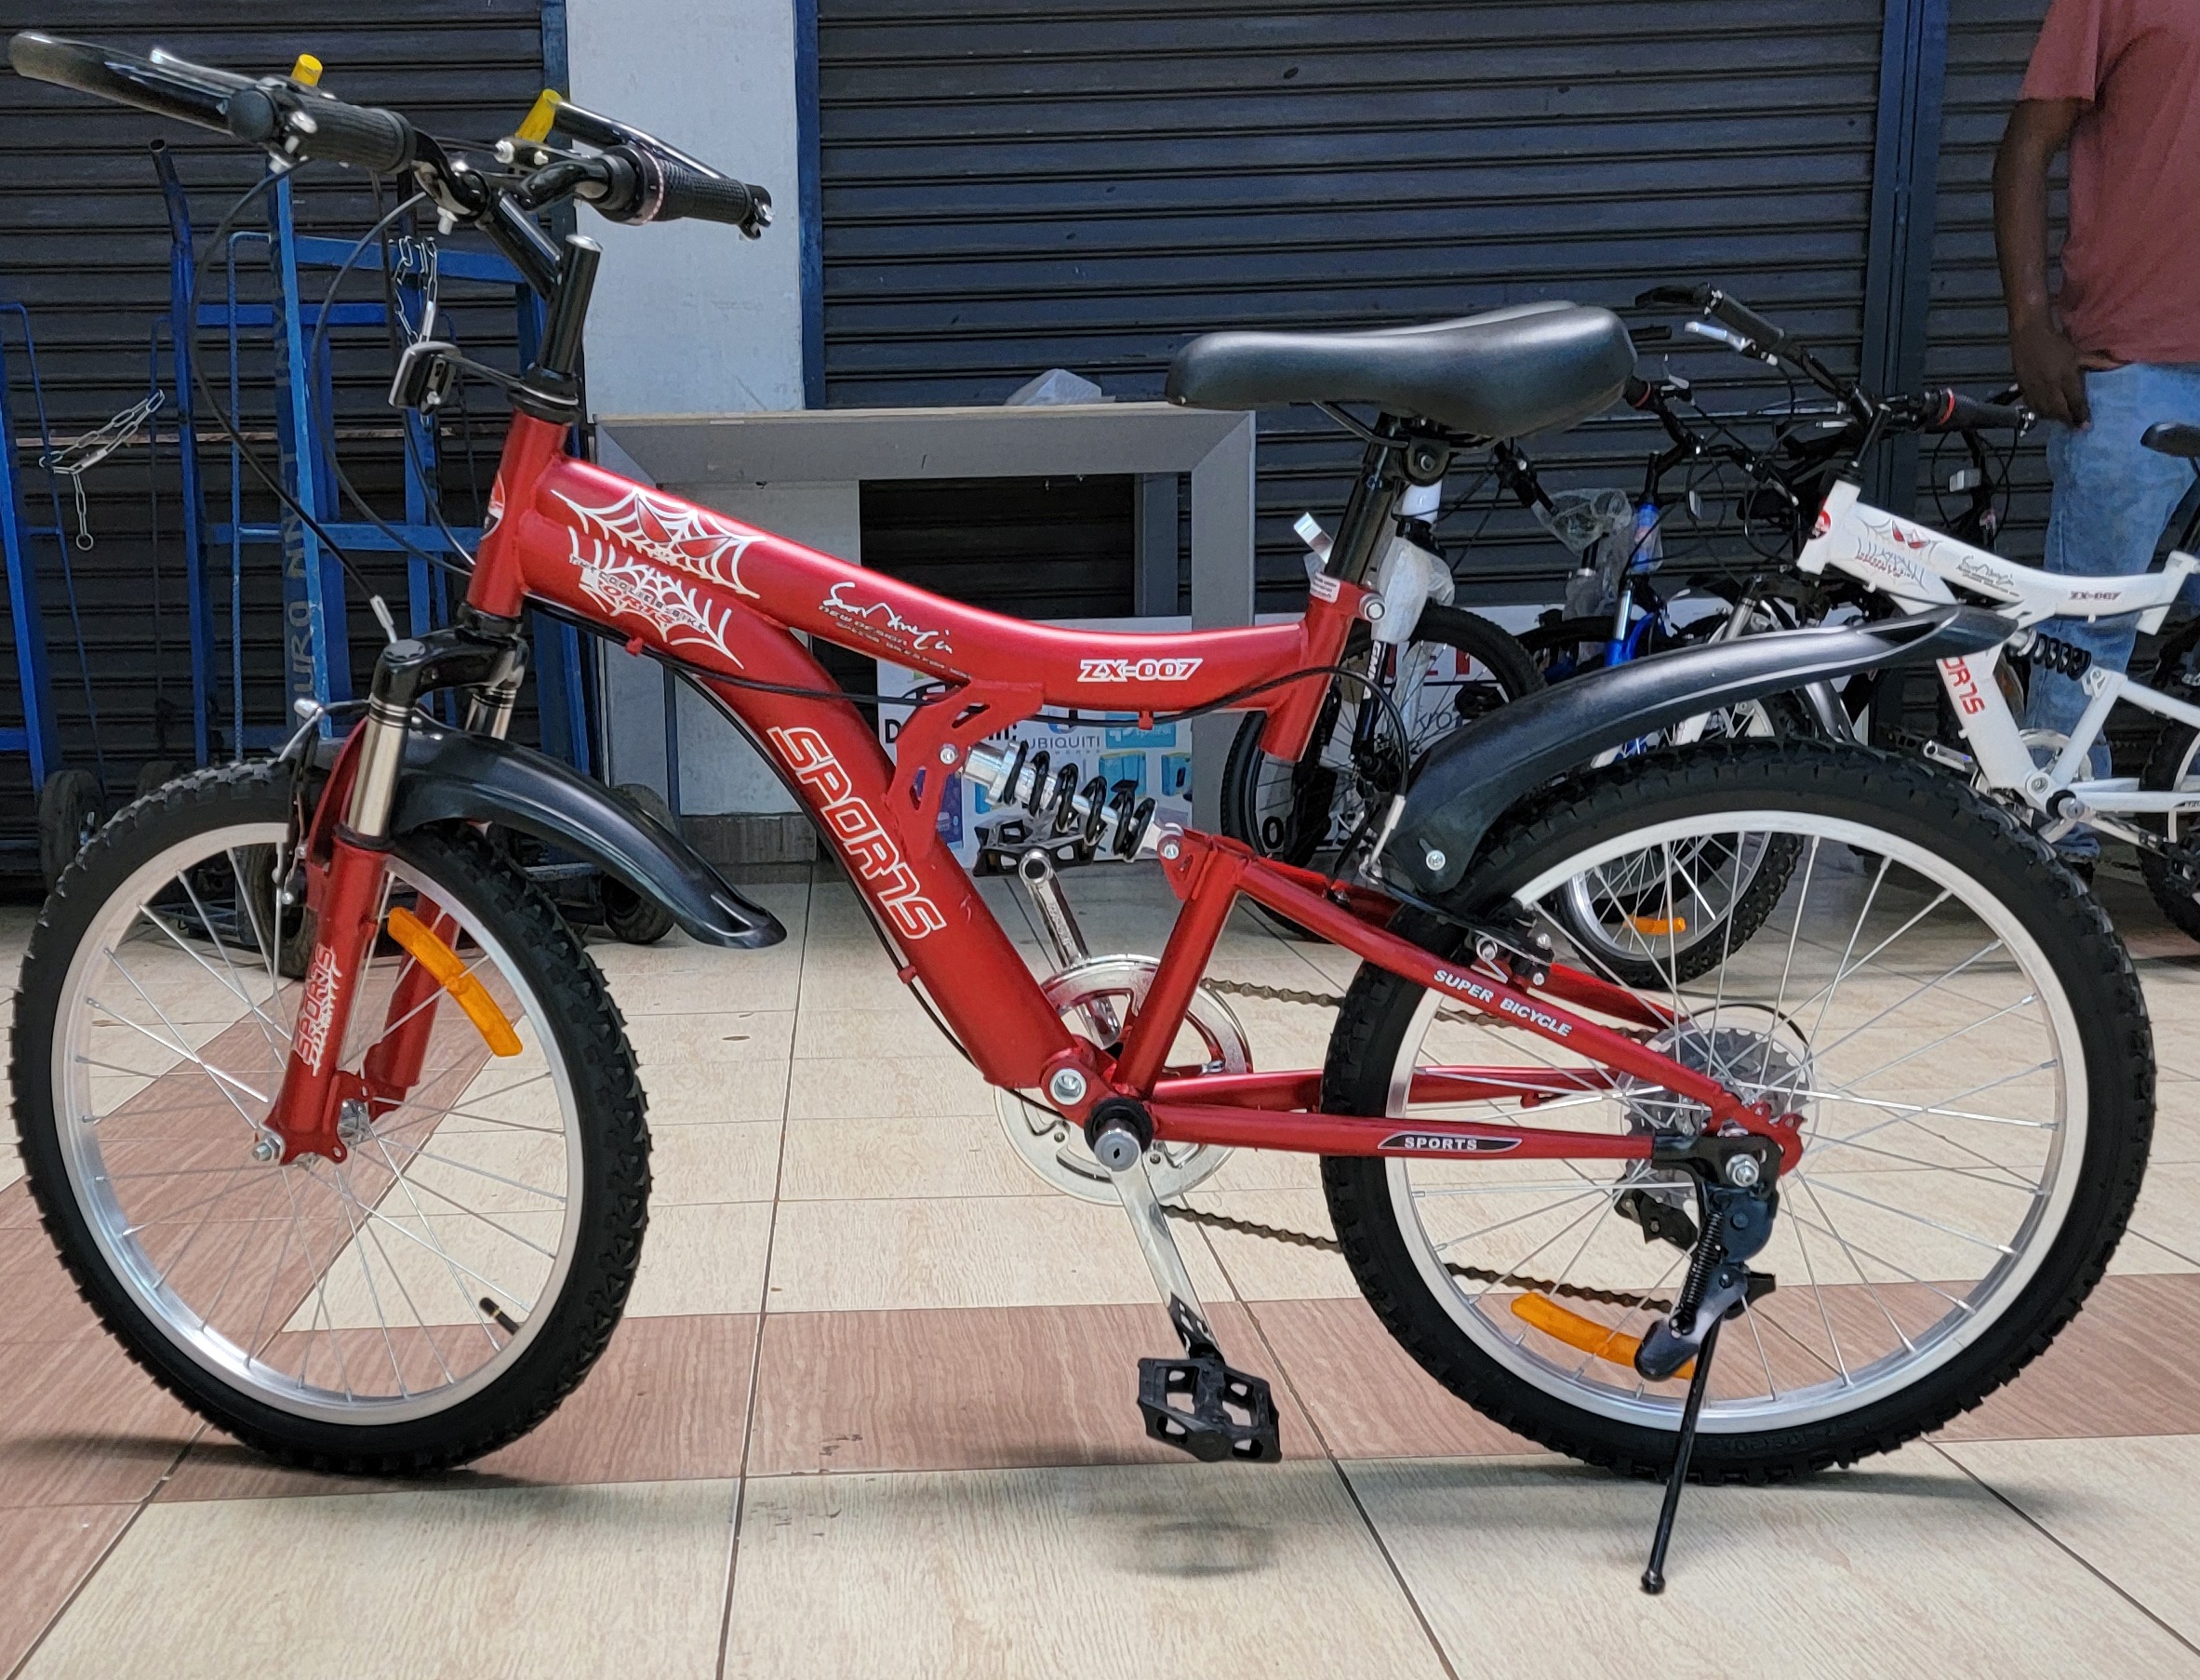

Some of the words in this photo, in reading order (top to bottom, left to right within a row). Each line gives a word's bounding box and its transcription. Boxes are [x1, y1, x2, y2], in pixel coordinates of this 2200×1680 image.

[1076, 658, 1204, 683] ZX-007
[1941, 656, 1985, 714] ORTS
[767, 726, 948, 940] SPORTS
[293, 941, 333, 1066] SPORTS
[1433, 969, 1495, 1004] SUPER
[1500, 997, 1572, 1037] BICYCLE
[1404, 1137, 1477, 1151] SPORTS
